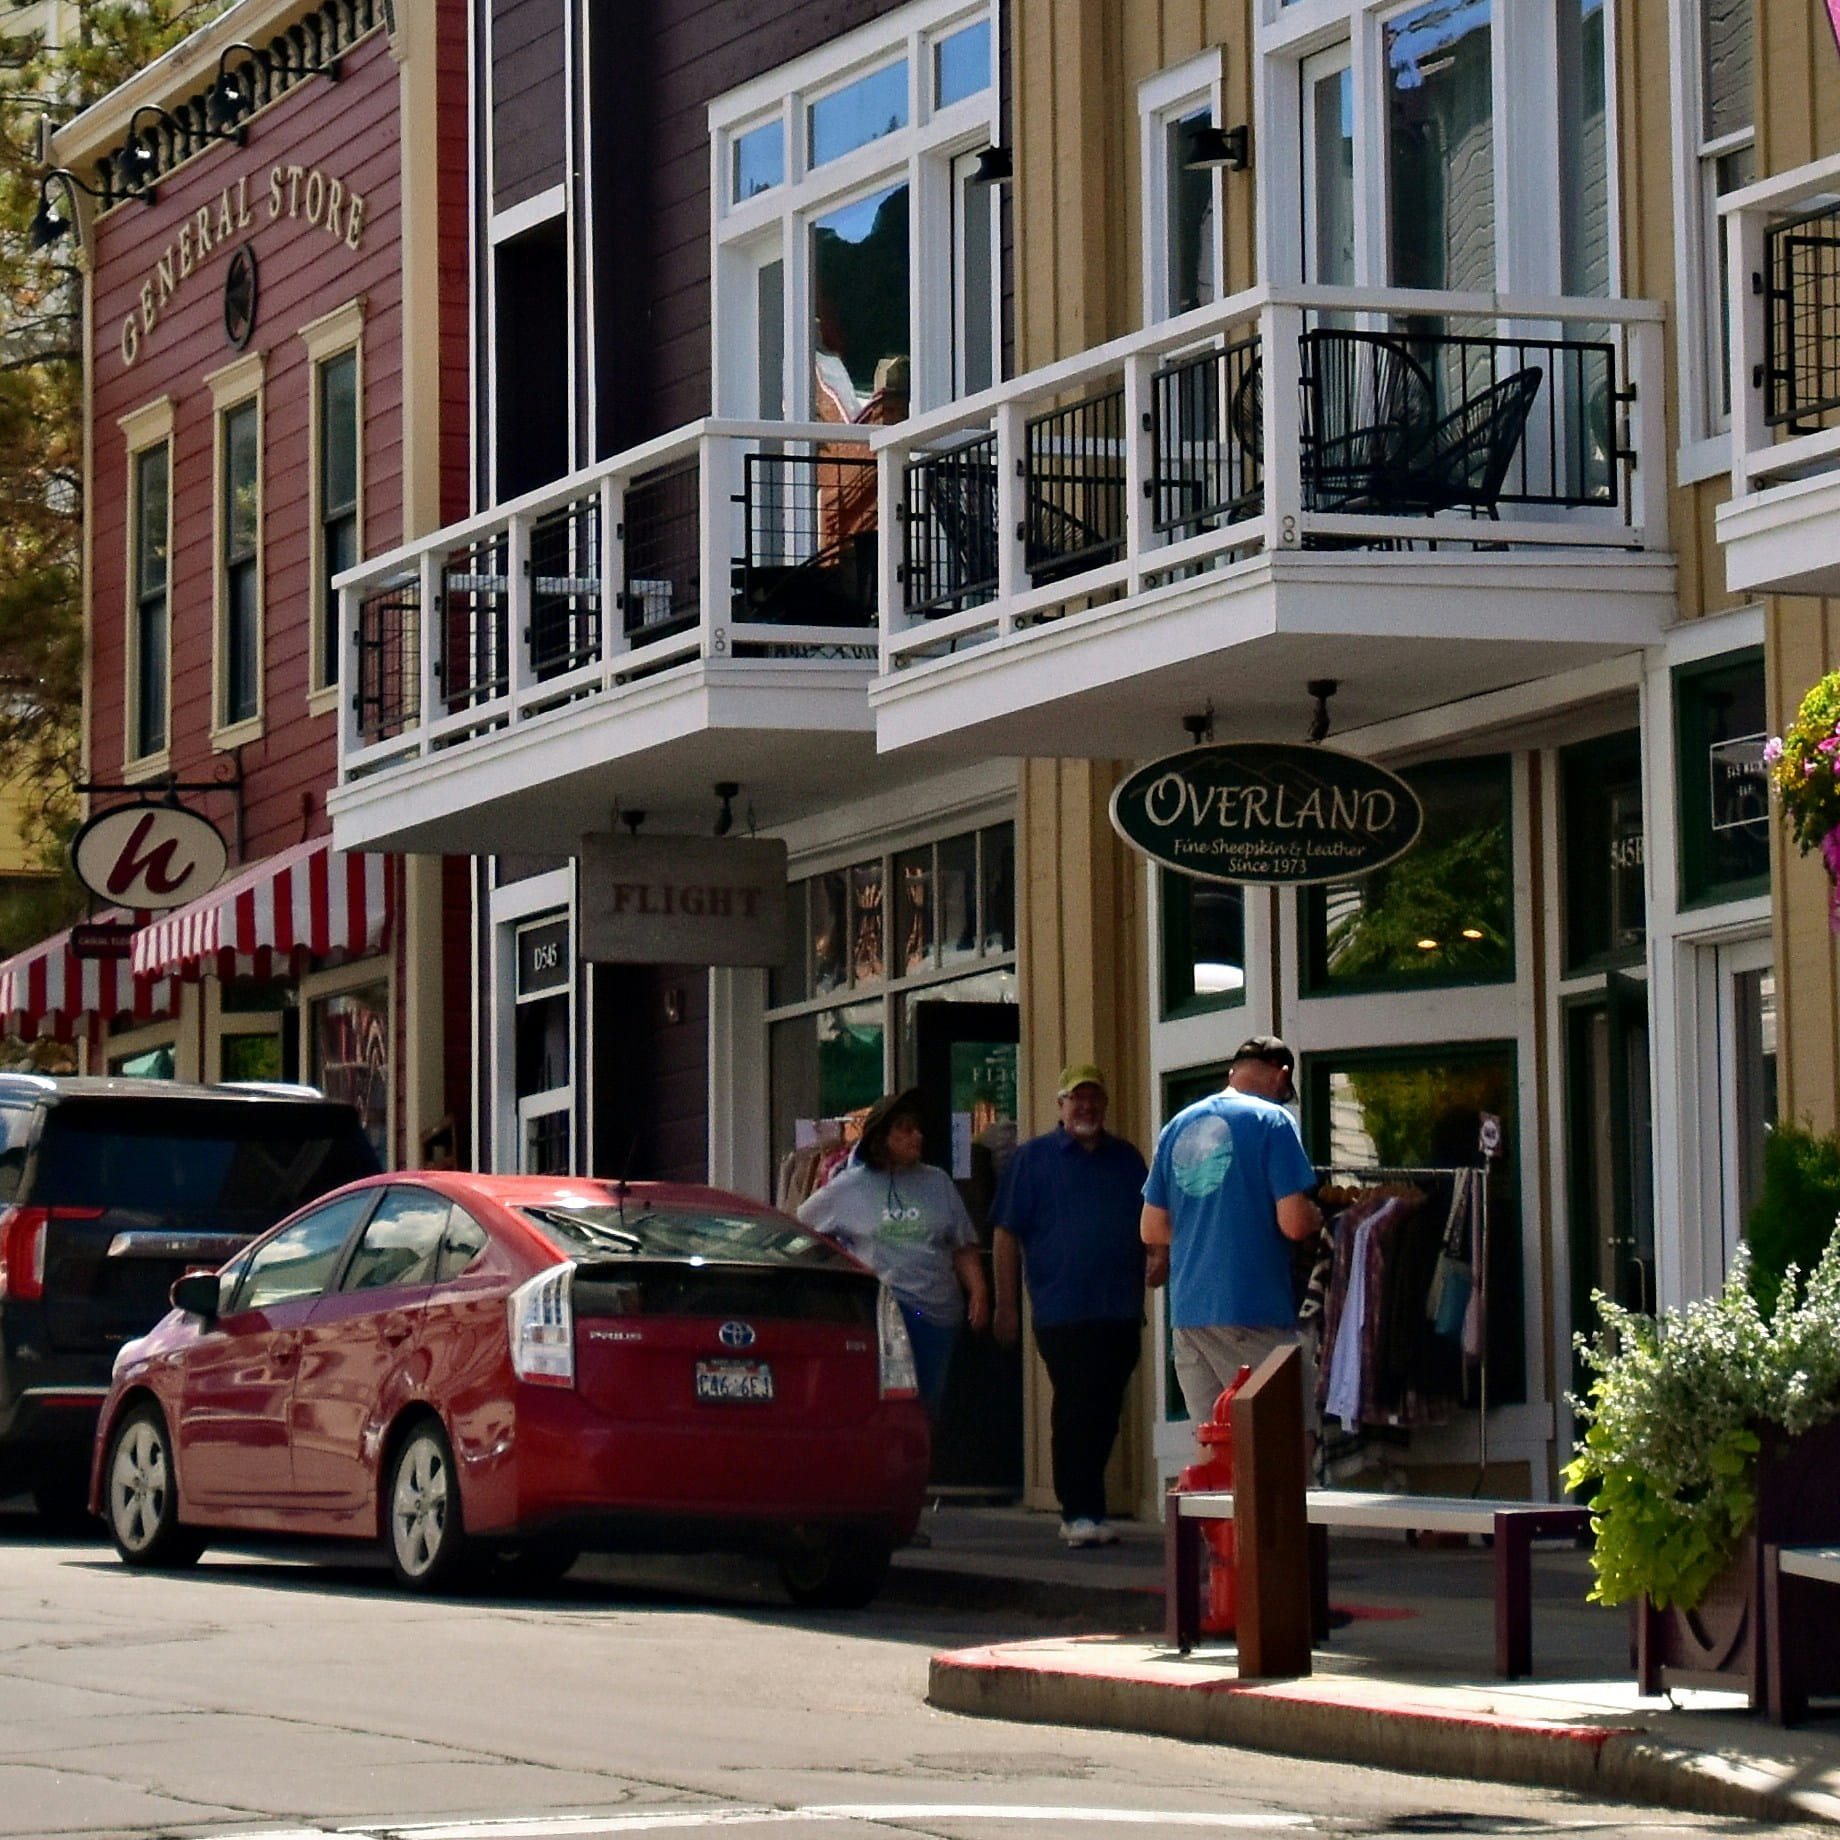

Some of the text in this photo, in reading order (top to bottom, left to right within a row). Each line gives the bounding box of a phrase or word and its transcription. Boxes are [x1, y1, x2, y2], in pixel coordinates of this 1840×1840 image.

[120, 164, 367, 366] GENERAL STORE
[1144, 771, 1396, 833] OVERLAND
[1174, 838, 1367, 859] Fine Sheepskin & Leather
[1228, 858, 1308, 874] Since 1973
[612, 882, 762, 918] FLIGHT
